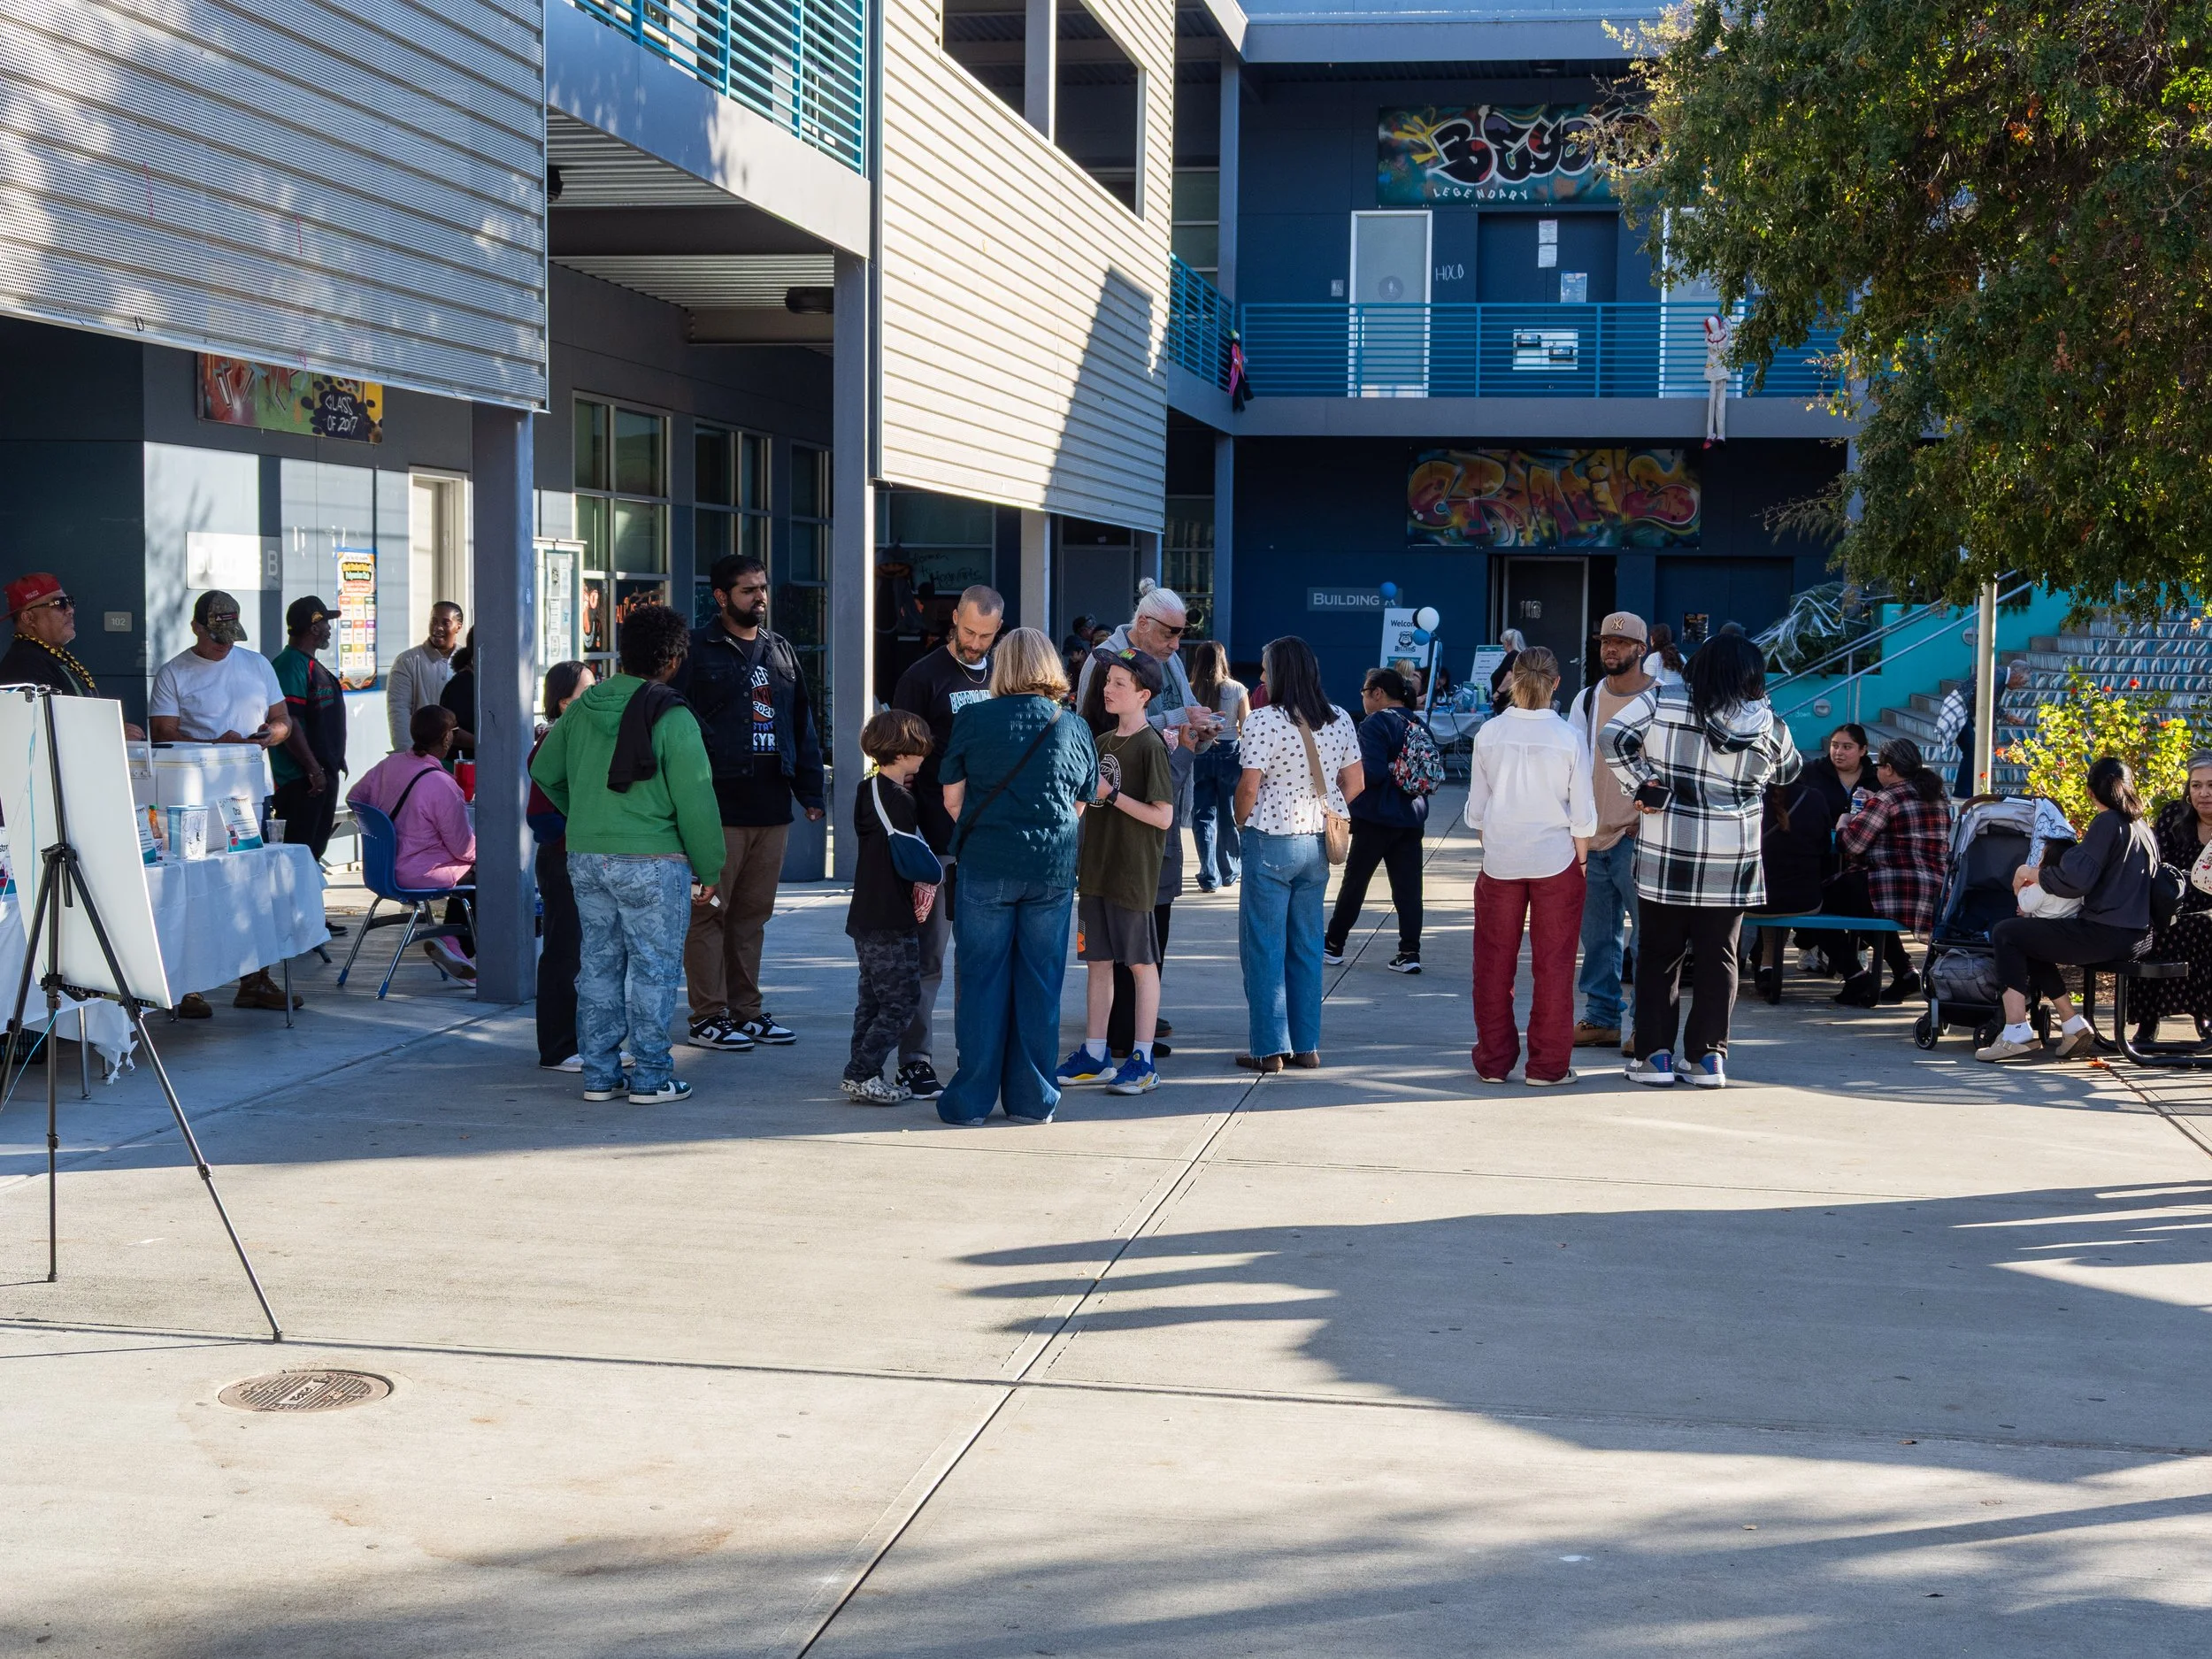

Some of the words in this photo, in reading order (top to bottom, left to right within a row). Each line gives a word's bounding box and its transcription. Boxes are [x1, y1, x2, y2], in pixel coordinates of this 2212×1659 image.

[1433, 187, 1528, 201] LEGENDARY
[325, 394, 353, 416] CLASS
[327, 415, 336, 431] OF
[337, 416, 358, 435] 2017
[267, 549, 278, 576] B
[1313, 593, 1379, 606] BUILDING
[111, 618, 126, 626] 102
